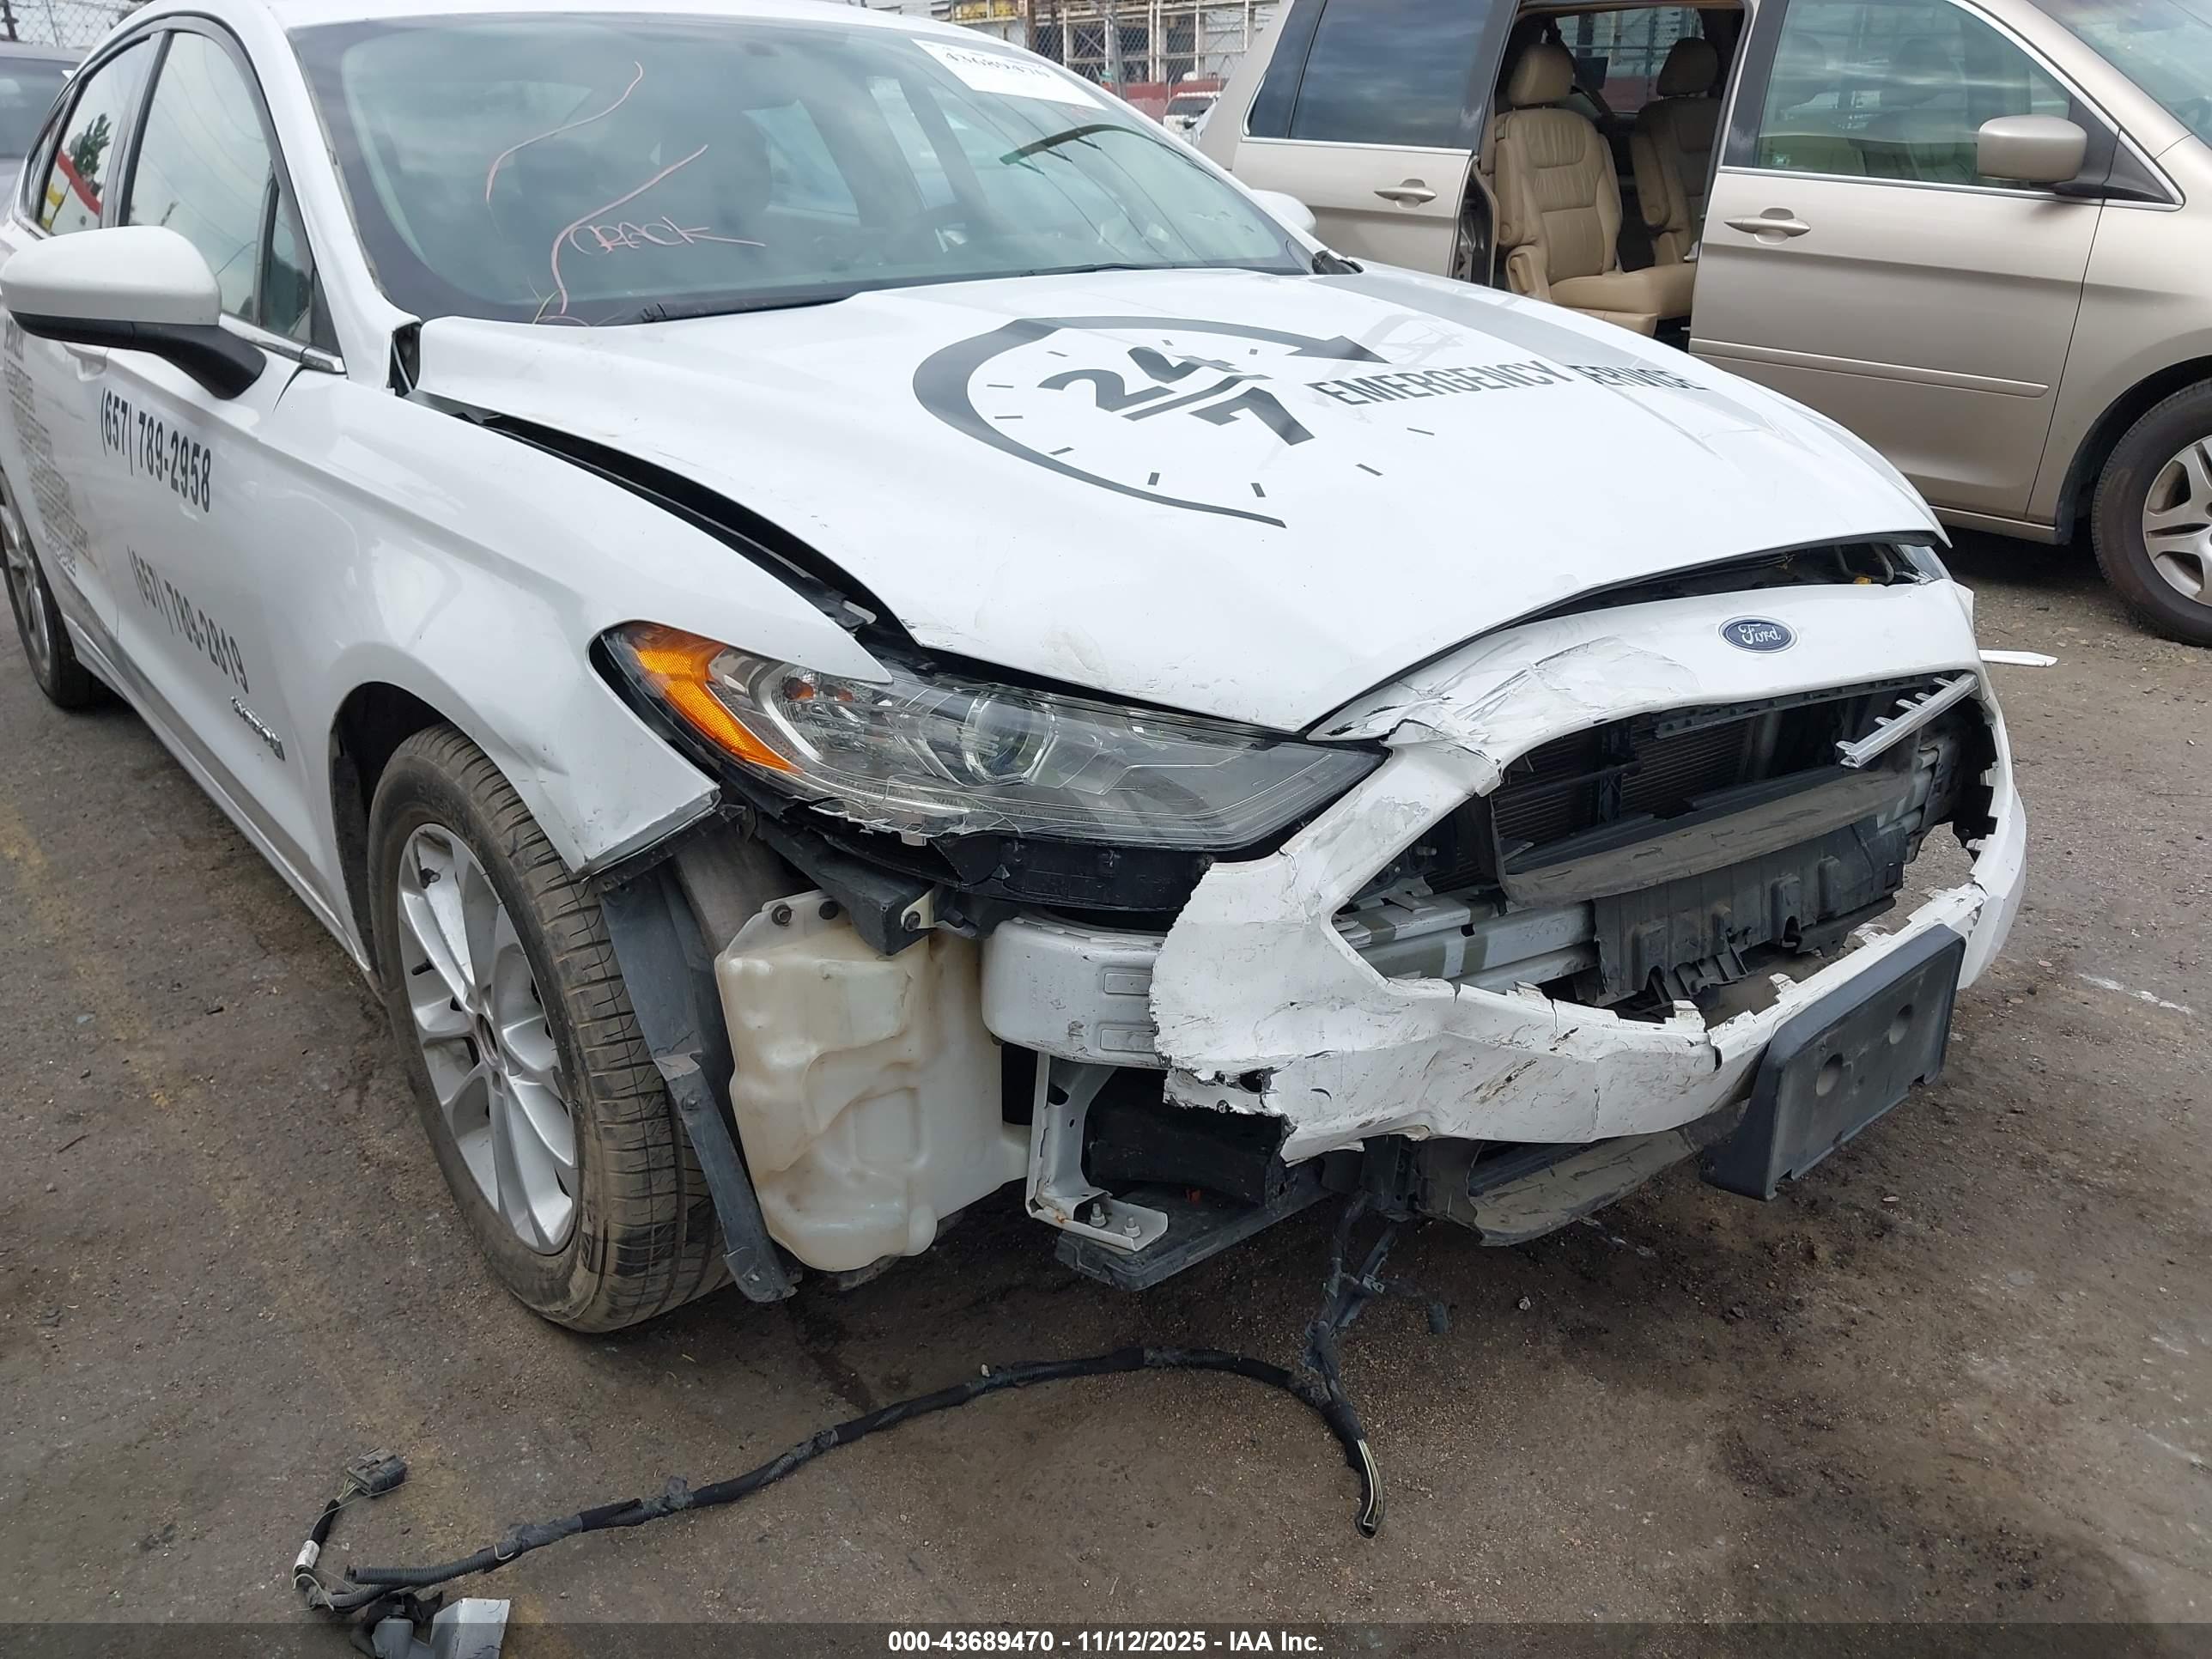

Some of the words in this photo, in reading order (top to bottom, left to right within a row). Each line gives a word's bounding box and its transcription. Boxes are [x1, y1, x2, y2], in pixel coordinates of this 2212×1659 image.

[1304, 360, 1574, 405] EMERGENCY
[1565, 365, 1711, 392] ERVICE
[138, 410, 211, 514] 789-2958
[164, 579, 249, 694] 789-2819
[1737, 623, 1782, 645] Ford
